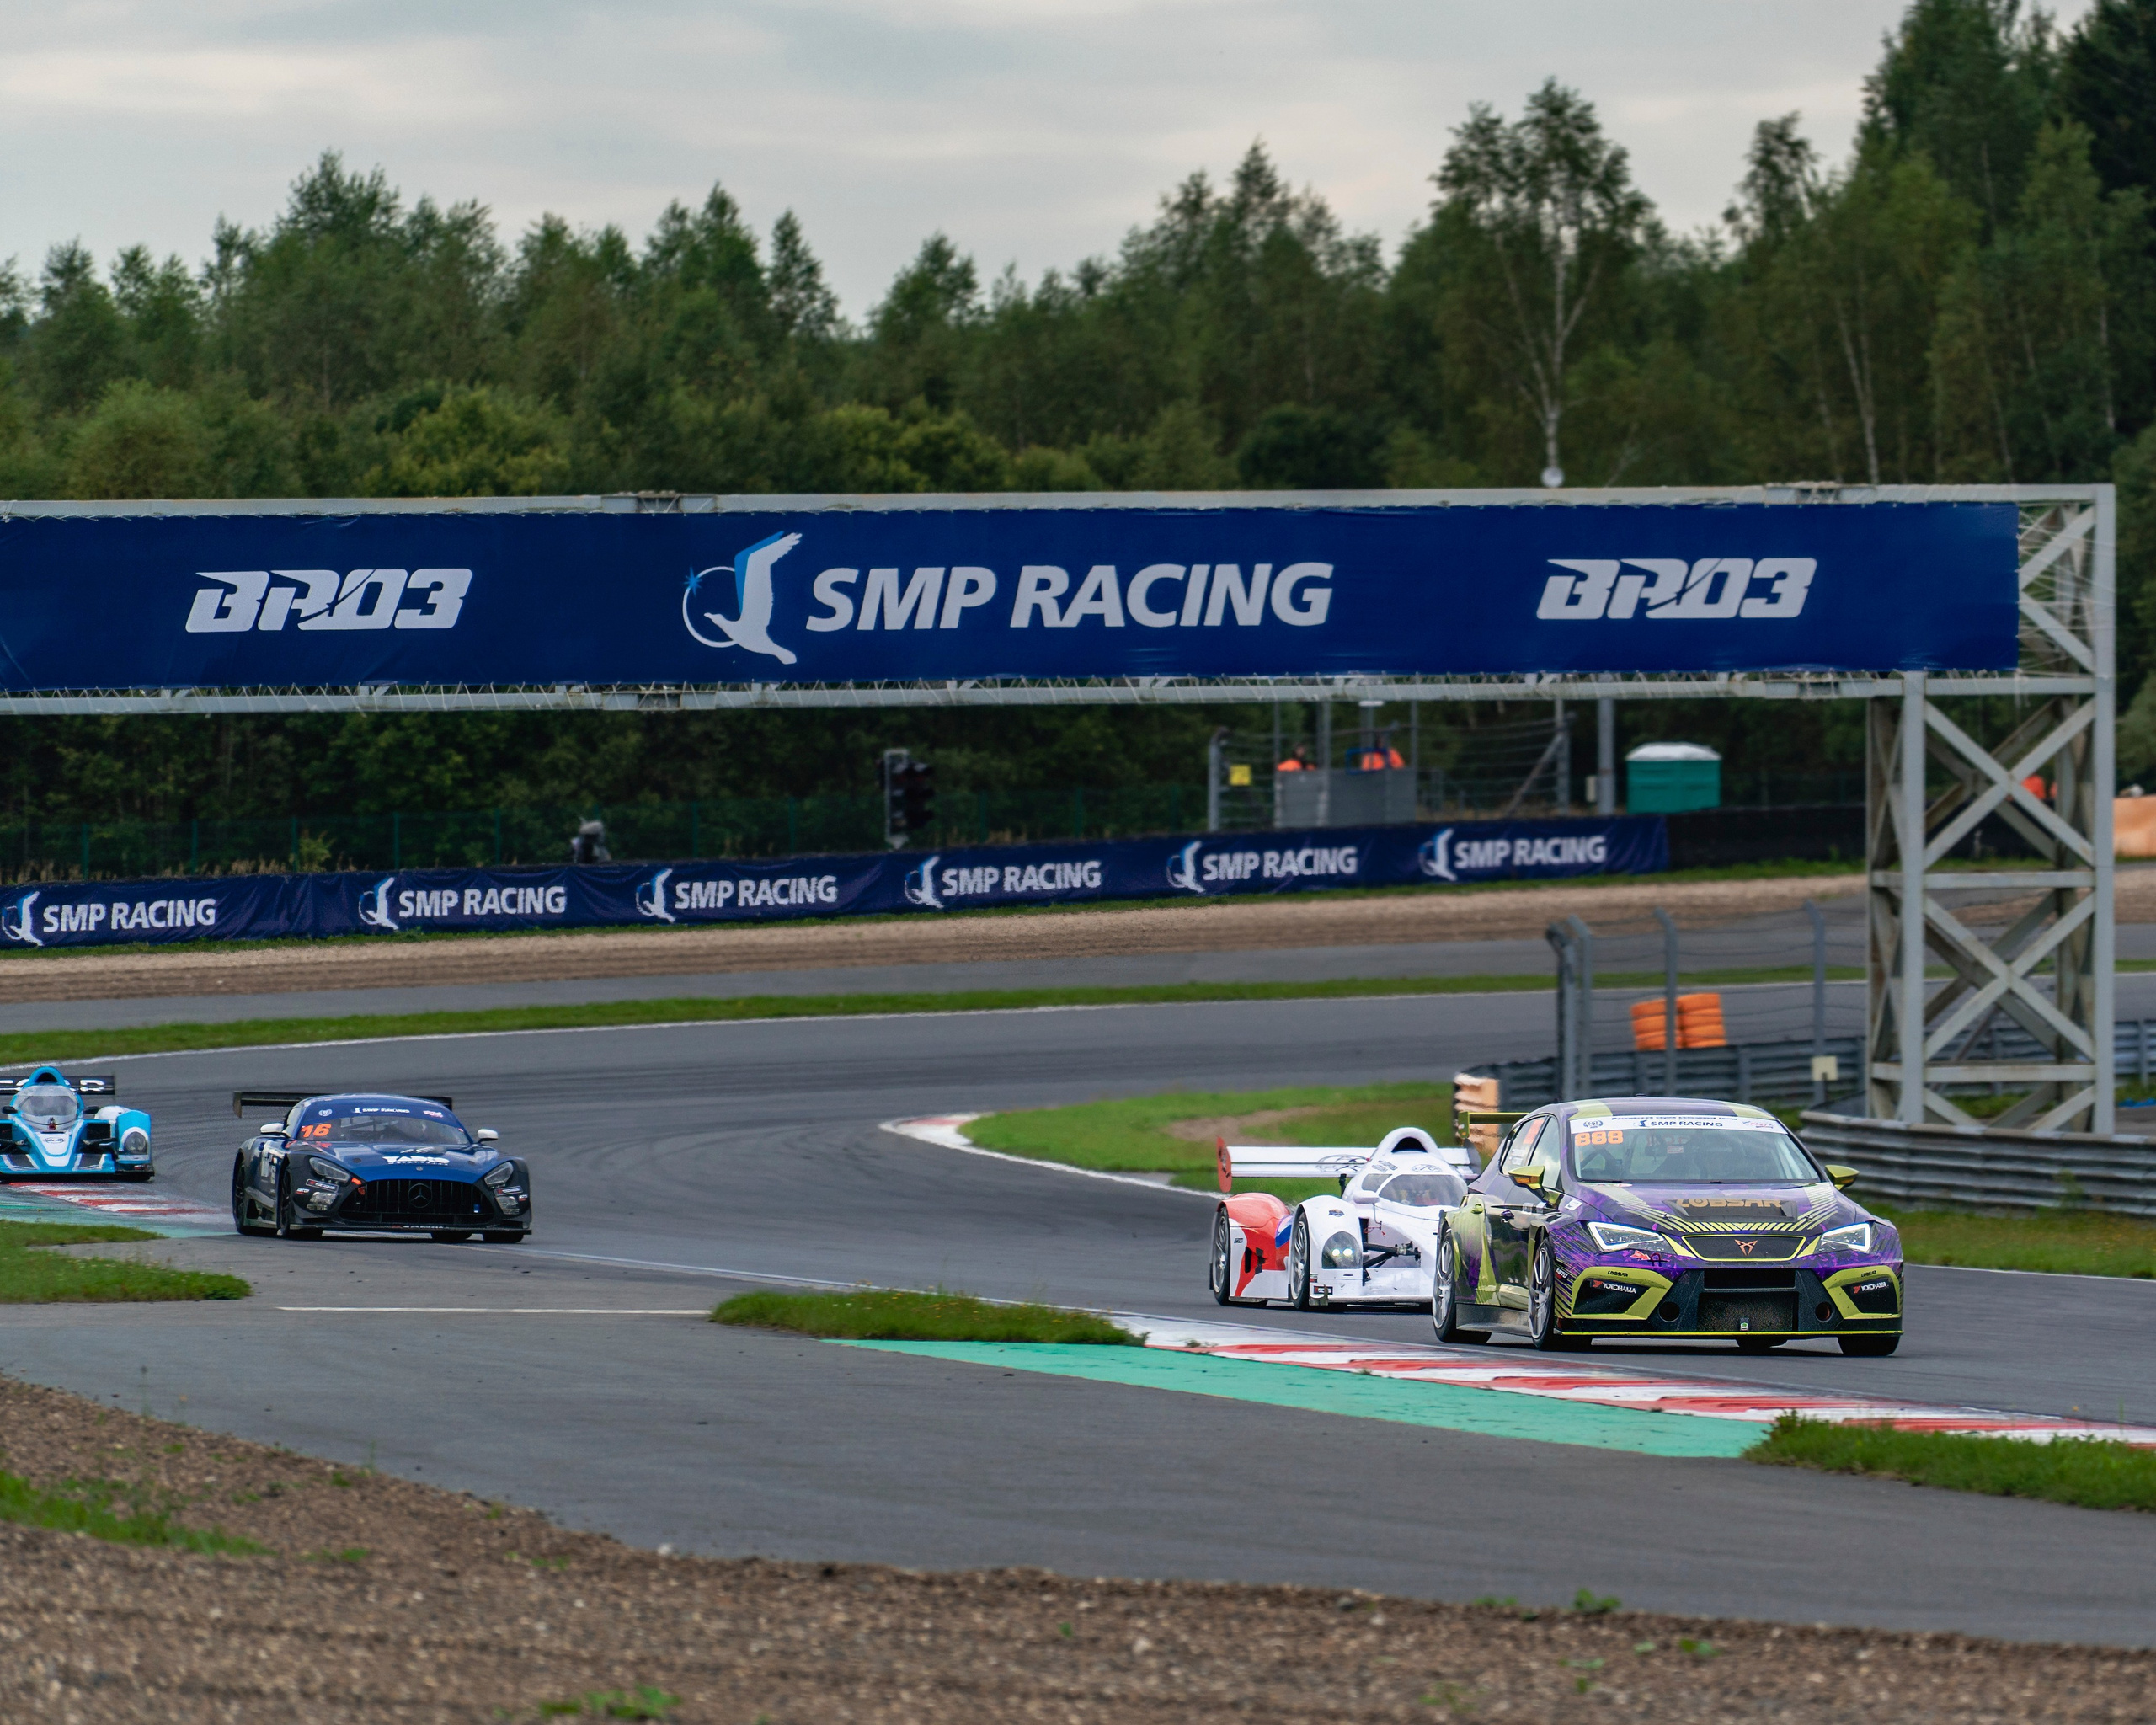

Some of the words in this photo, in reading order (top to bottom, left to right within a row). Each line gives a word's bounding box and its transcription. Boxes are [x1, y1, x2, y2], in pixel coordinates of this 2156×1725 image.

[805, 566, 997, 632] SMP
[1010, 562, 1333, 628] RACING
[1203, 852, 1260, 881] SMP
[1263, 847, 1357, 878] RACING
[1455, 840, 1510, 868] SMP
[1513, 836, 1605, 865] RACING
[675, 880, 734, 910] SMP
[737, 875, 838, 907] RACING
[942, 867, 999, 896] SMP
[1003, 861, 1102, 893] RACING
[43, 903, 106, 933] SMP
[110, 898, 216, 930] RACING
[398, 889, 459, 918] SMP
[463, 886, 566, 916] RACING
[301, 1123, 332, 1138] 16
[1574, 1130, 1624, 1146] 888
[1602, 1282, 1637, 1294] YOKOHAMA
